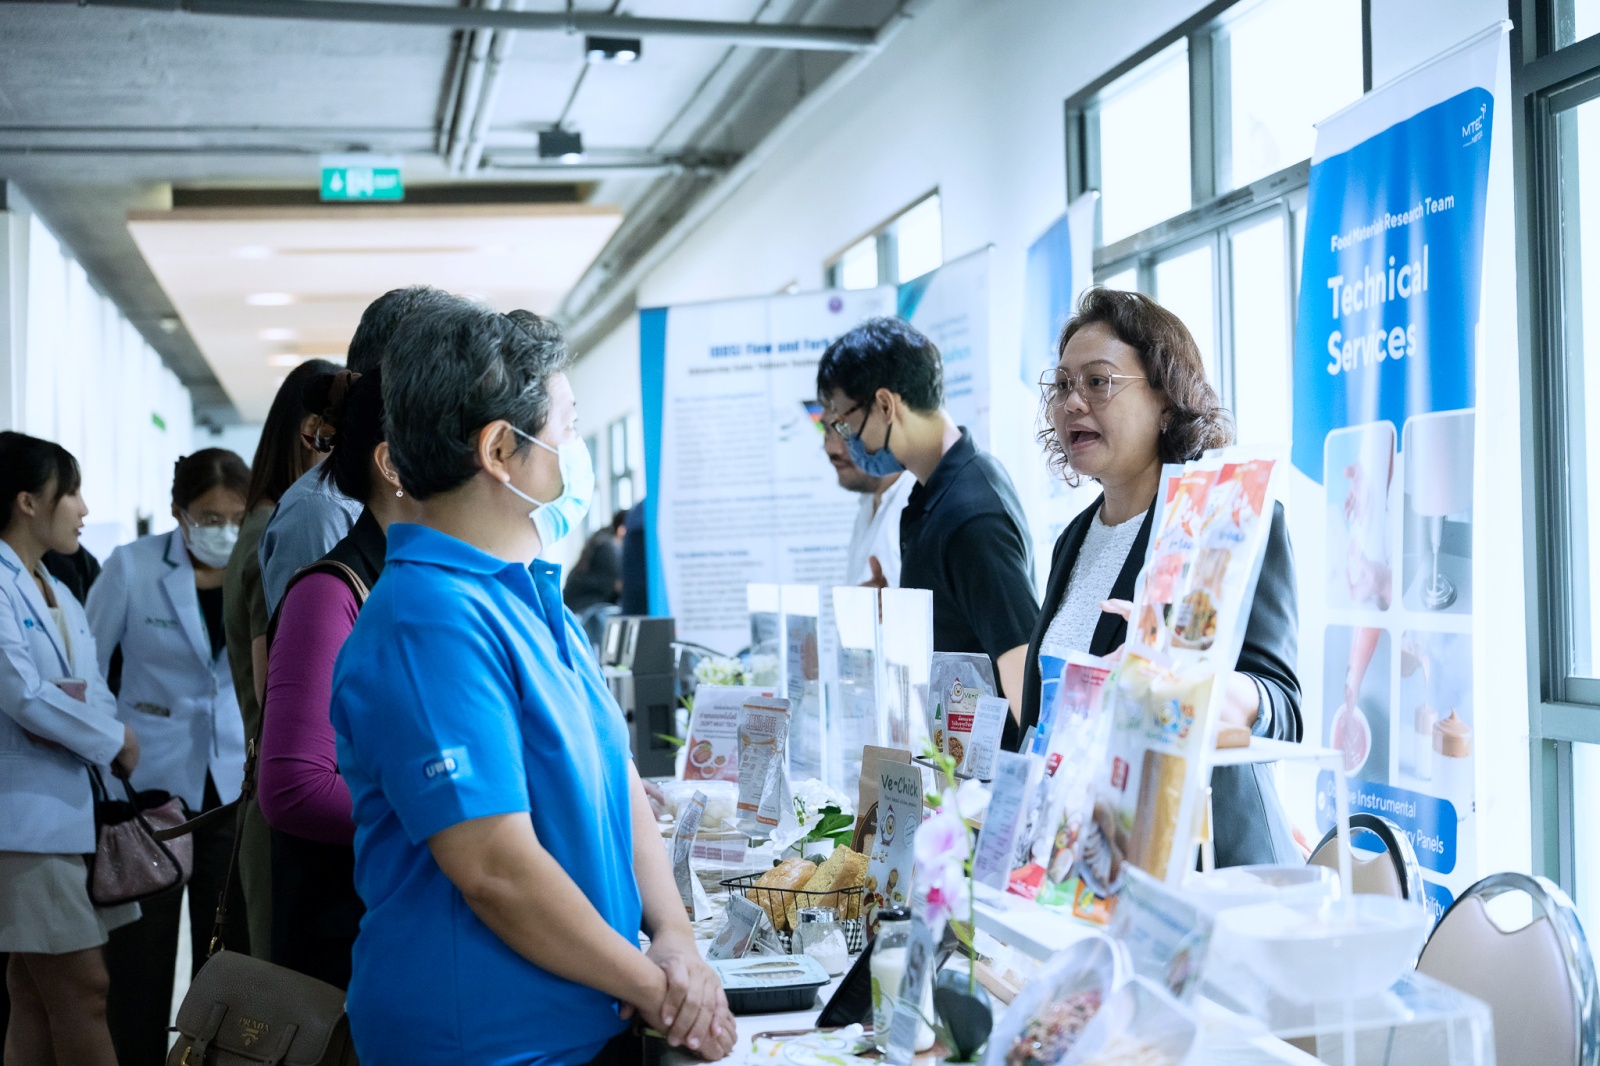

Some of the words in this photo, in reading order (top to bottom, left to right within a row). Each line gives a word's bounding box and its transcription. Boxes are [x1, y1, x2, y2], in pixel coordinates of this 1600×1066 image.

[1462, 115, 1483, 138] MTEC
[1331, 234, 1352, 253] Food
[1353, 218, 1383, 243] Materials
[1384, 201, 1424, 230] Research
[1425, 195, 1455, 215] Team
[1327, 244, 1429, 320] Technical
[1327, 321, 1417, 376] Services
[1358, 790, 1417, 818] Instrumental
[1417, 829, 1445, 855] Panels
